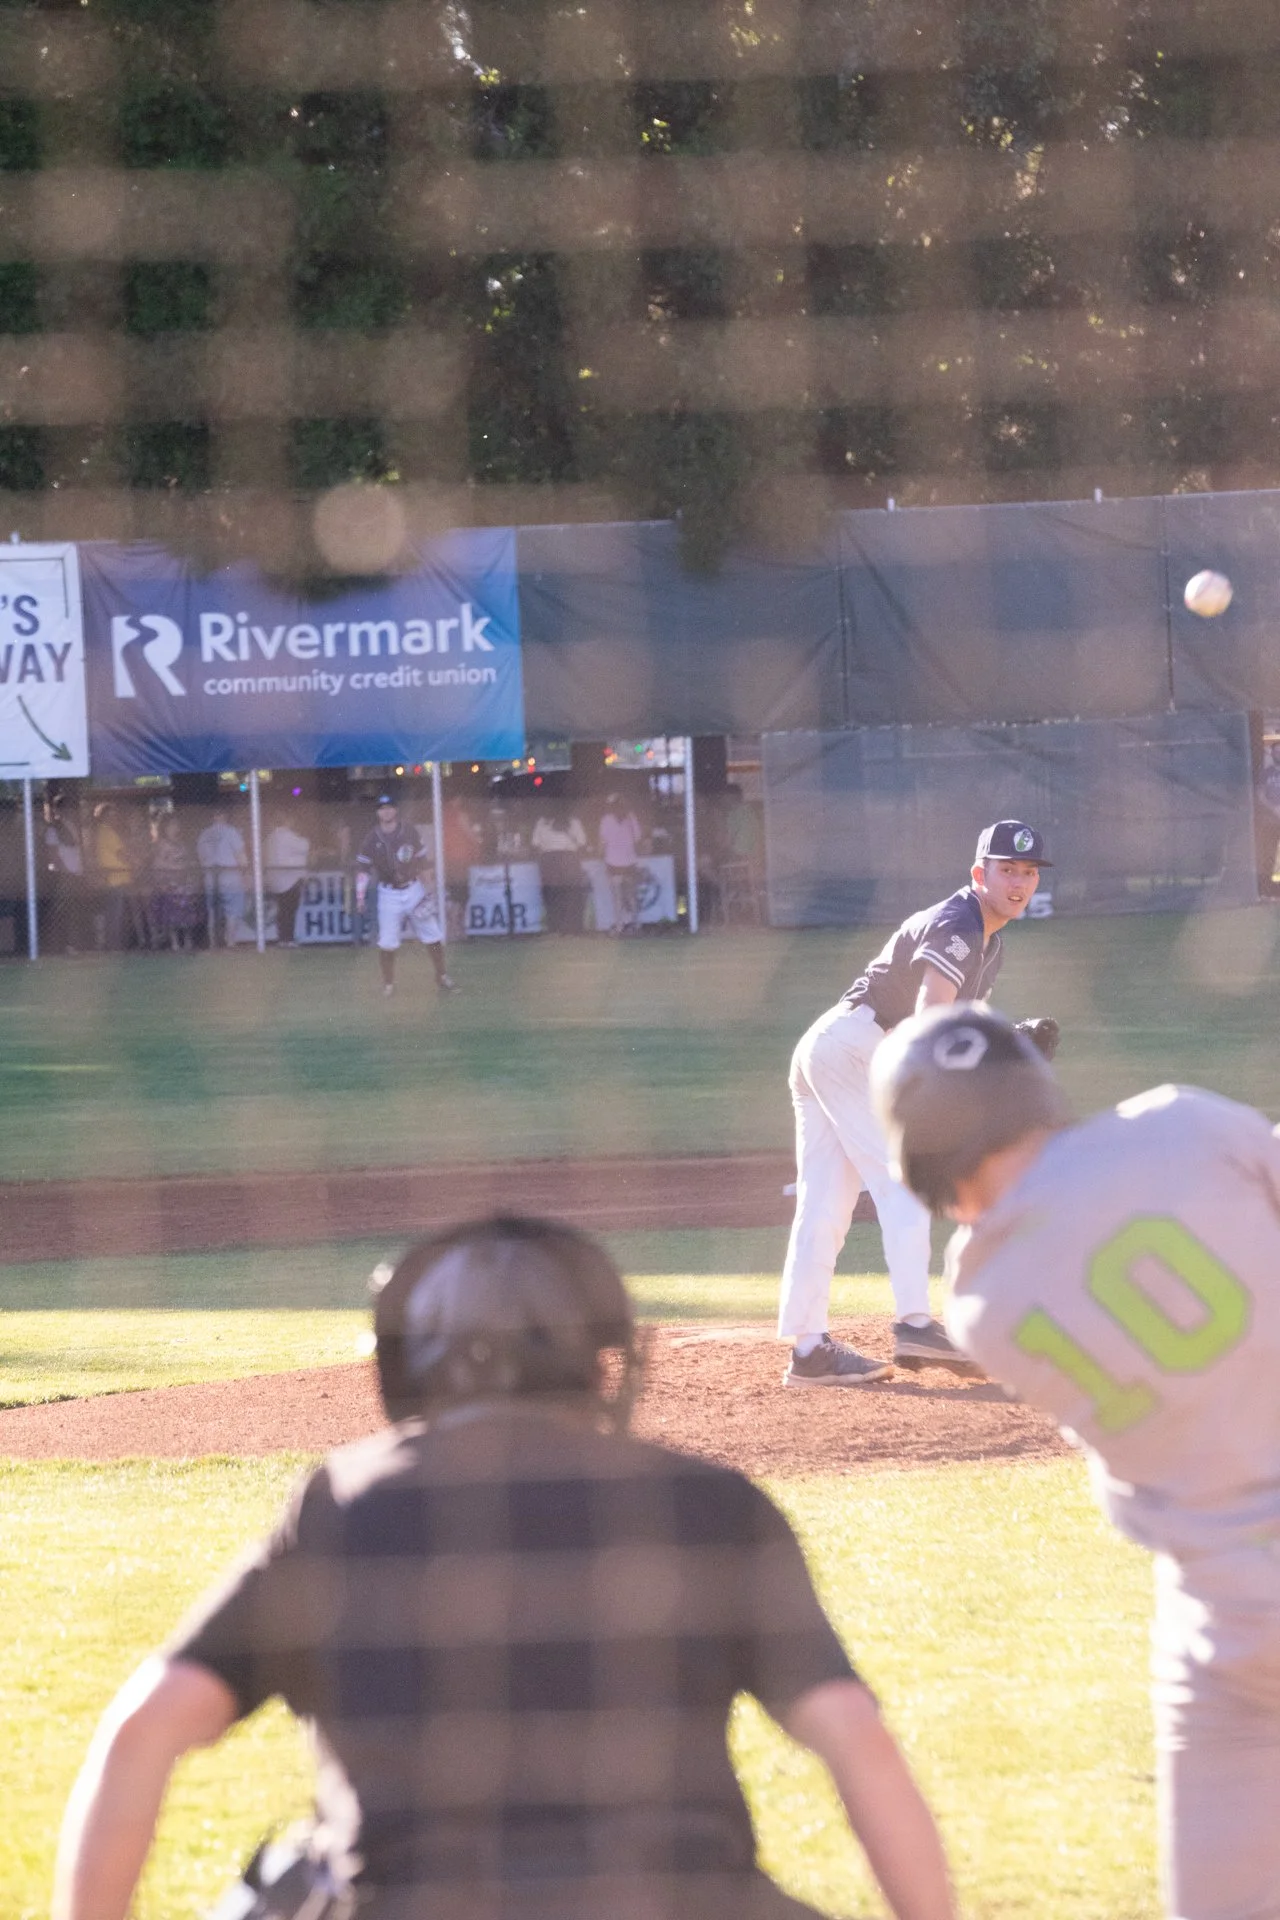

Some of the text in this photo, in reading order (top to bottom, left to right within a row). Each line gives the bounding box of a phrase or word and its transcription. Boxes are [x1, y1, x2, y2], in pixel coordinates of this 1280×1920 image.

[199, 602, 494, 663] Rivermark
[203, 662, 497, 696] community credit union
[469, 903, 527, 930] BAR
[1012, 1216, 1253, 1434] 10
